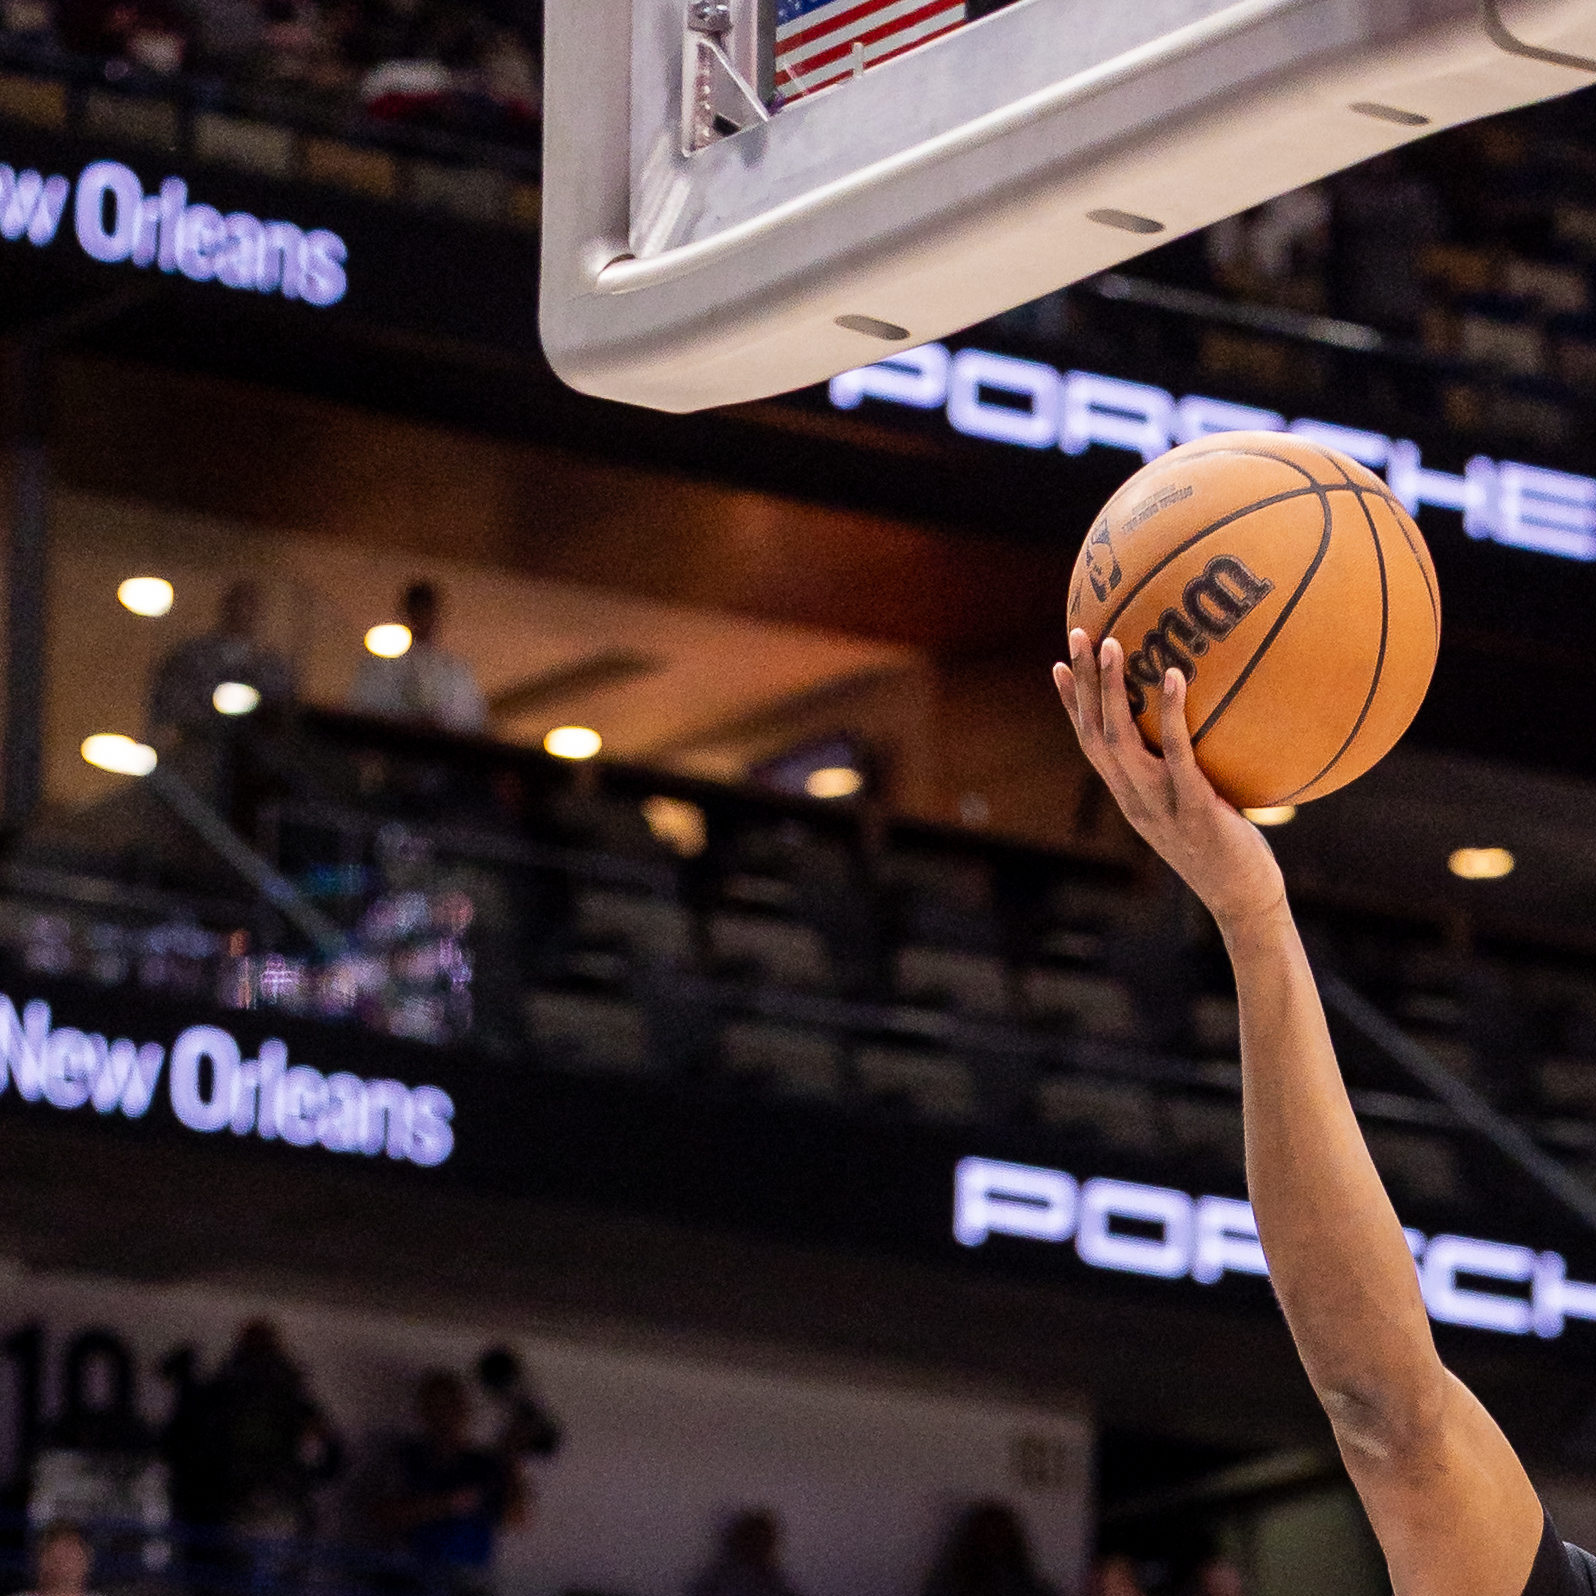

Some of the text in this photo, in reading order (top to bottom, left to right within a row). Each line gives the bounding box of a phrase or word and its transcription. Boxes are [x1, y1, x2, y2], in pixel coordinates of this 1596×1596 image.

[75, 159, 348, 308] Orleans
[1124, 554, 1276, 716] Wils
[169, 1024, 455, 1167] Orleans
